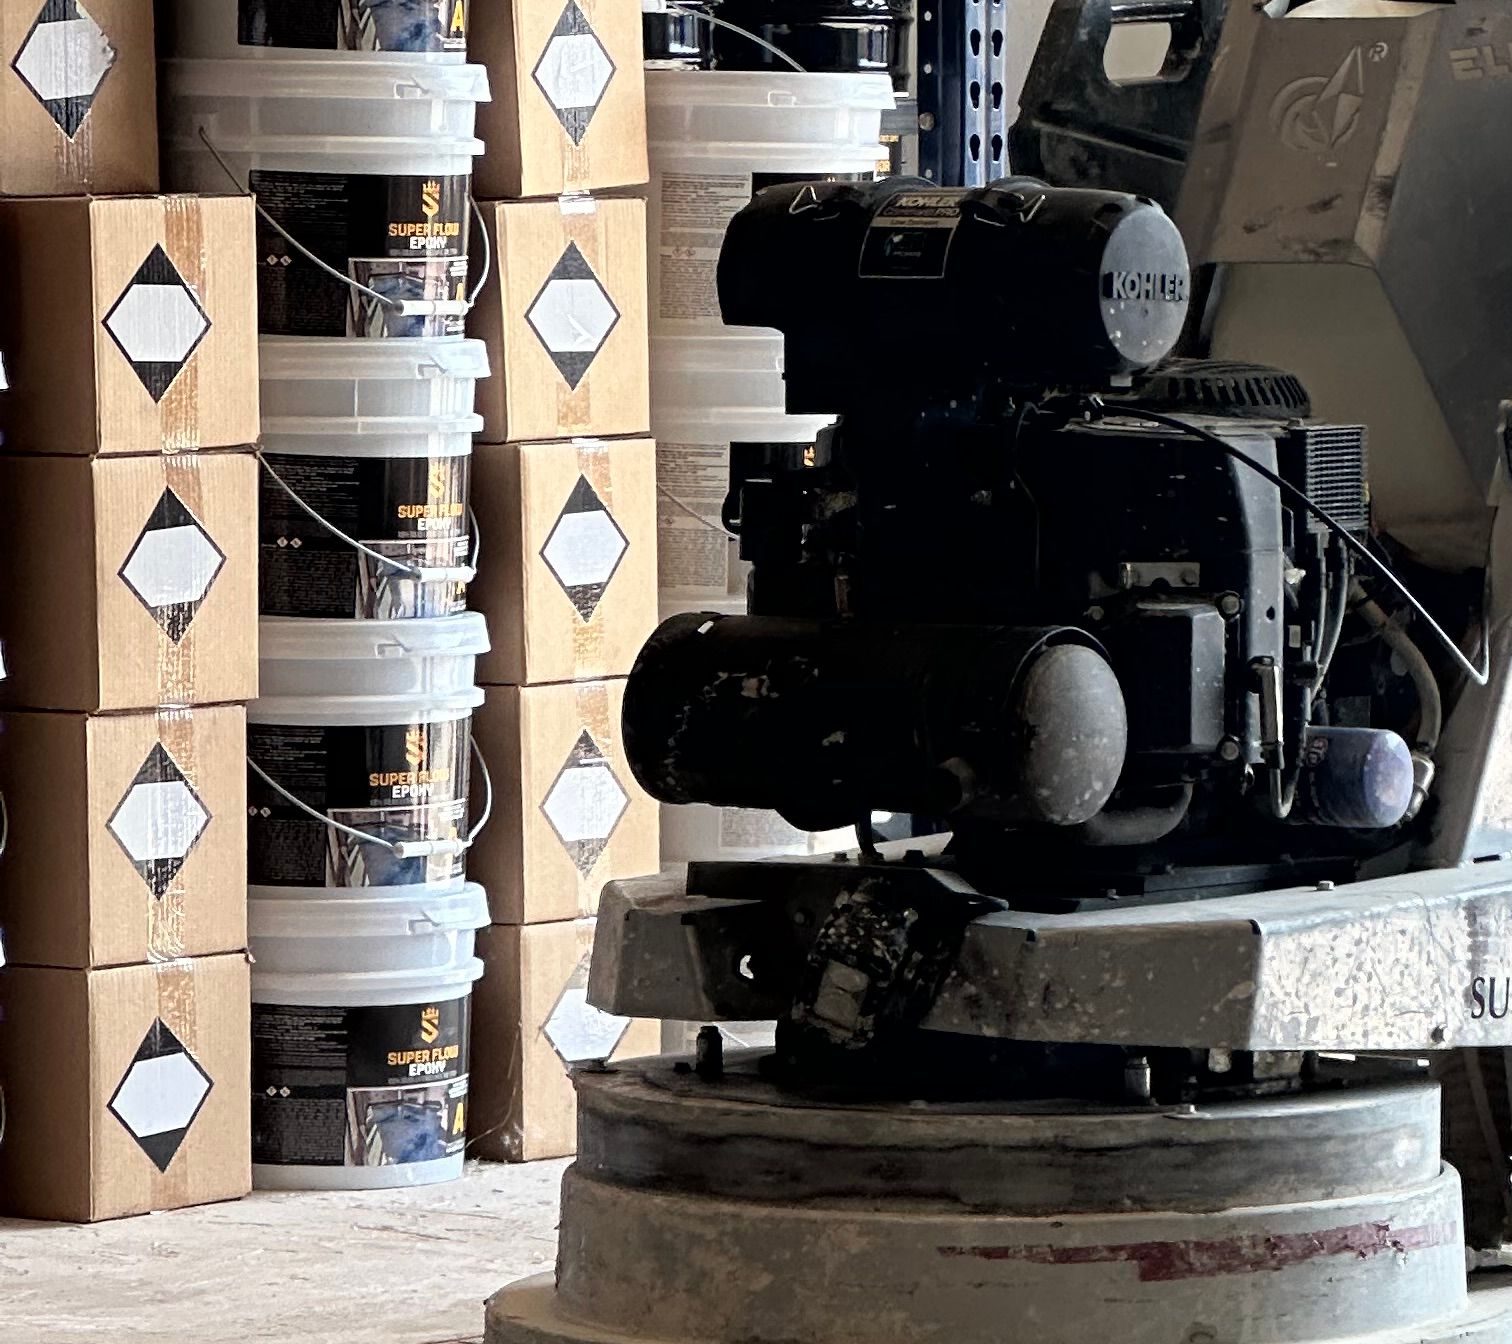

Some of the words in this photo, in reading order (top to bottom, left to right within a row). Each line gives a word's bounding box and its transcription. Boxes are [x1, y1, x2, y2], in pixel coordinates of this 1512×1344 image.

[451, 0, 464, 32] A
[388, 222, 431, 237] SUPER
[409, 236, 447, 250] EPOXY
[1112, 271, 1187, 301] KOHLER
[398, 505, 437, 519] SUPER
[369, 771, 415, 787] SUPER
[392, 784, 435, 798] EPOXY
[387, 1049, 430, 1065] SUPER
[432, 1045, 459, 1061] FLOW
[409, 1060, 447, 1077] EPOXY
[453, 1102, 464, 1135] A
